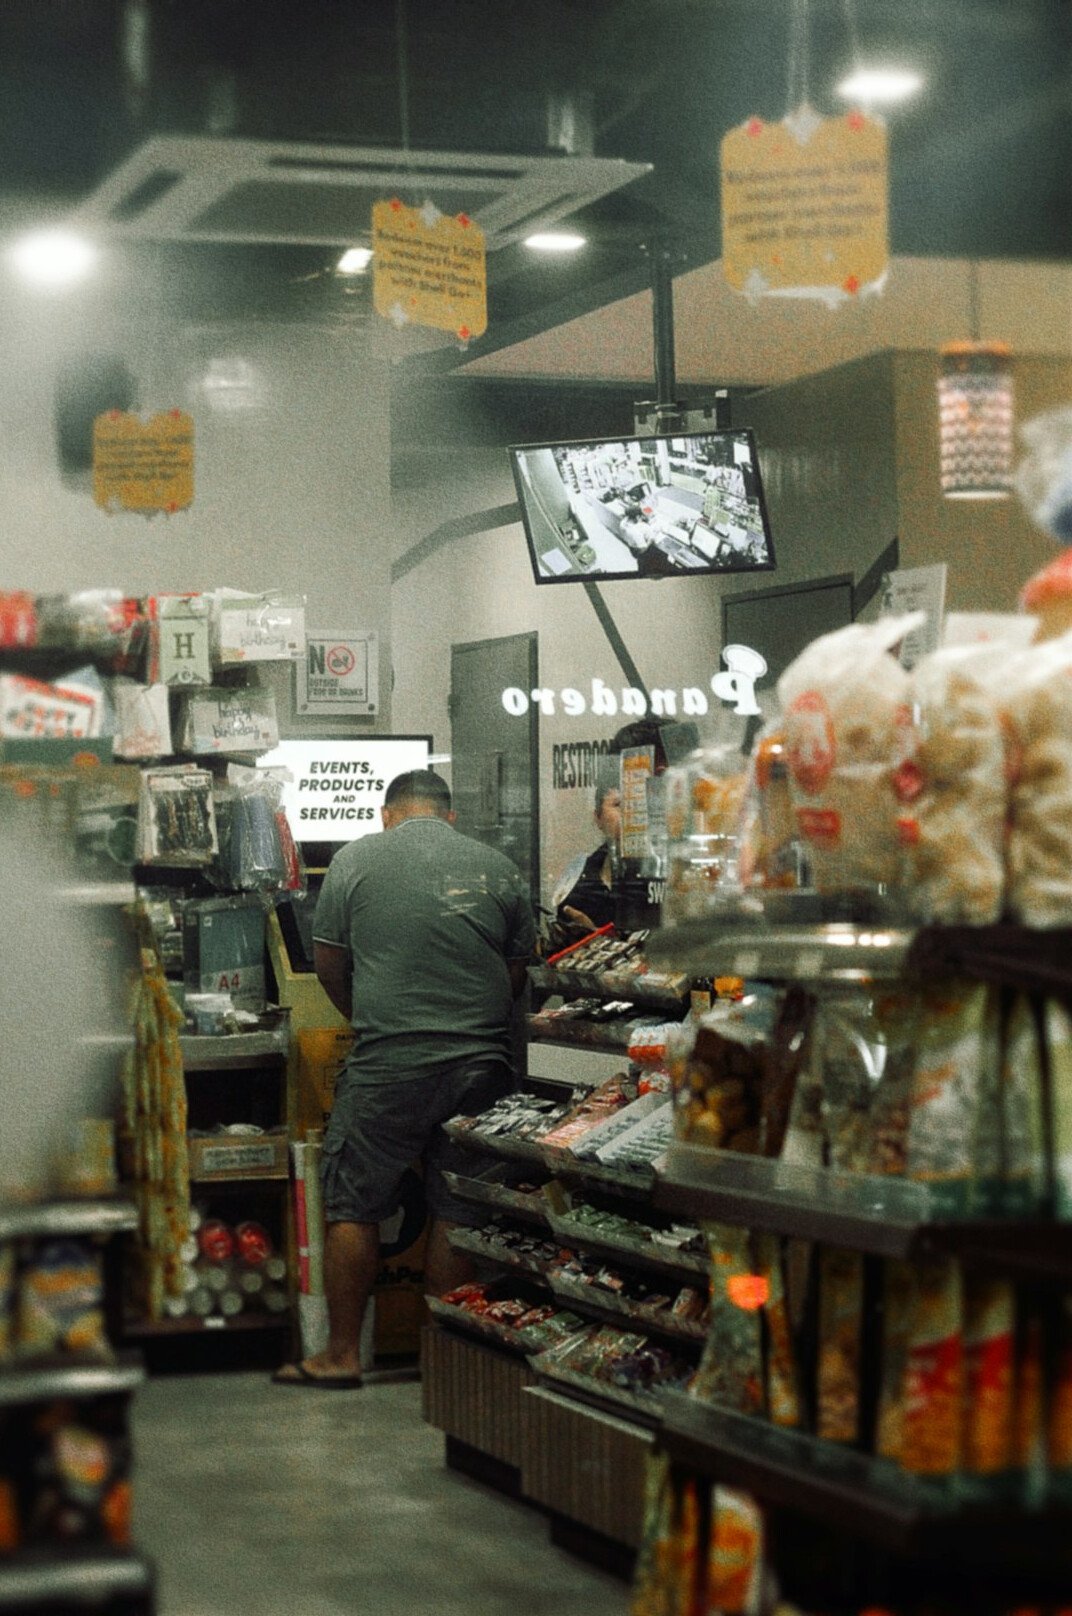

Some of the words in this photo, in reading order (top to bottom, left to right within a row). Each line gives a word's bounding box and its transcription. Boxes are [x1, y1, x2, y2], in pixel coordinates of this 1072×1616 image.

[172, 631, 195, 660] H
[309, 761, 375, 775] EVENTS,
[298, 779, 385, 792] PRODUCTS
[333, 794, 356, 804] AND
[299, 807, 375, 820] SERVICES
[218, 972, 241, 992] A4
